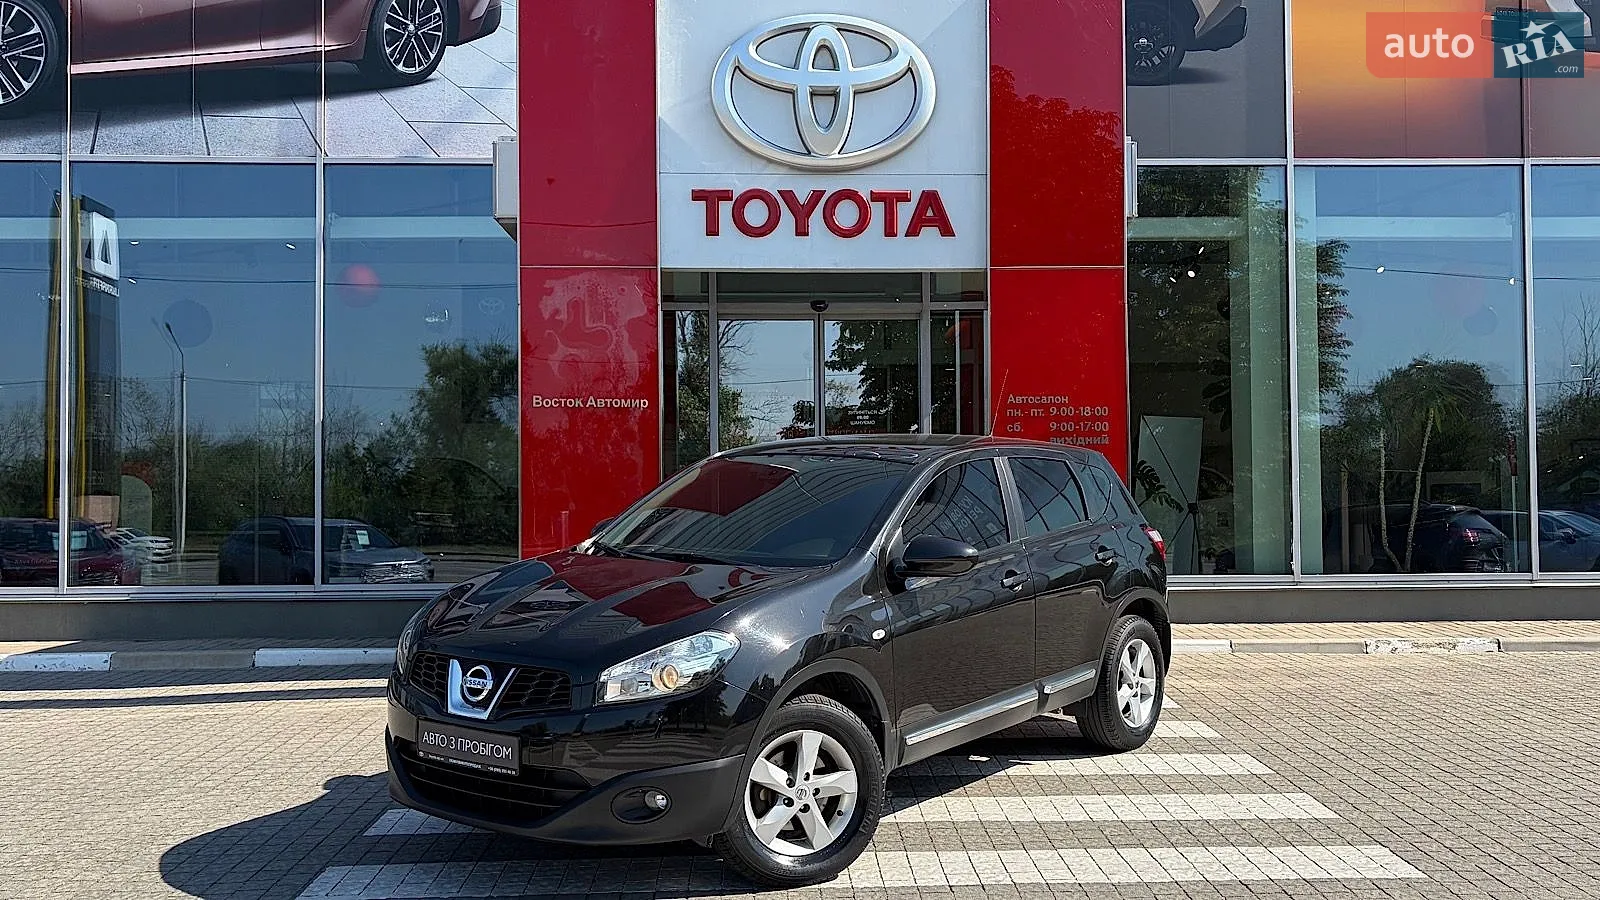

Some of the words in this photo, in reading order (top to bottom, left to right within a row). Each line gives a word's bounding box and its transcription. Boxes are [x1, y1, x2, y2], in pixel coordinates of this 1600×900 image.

[691, 188, 956, 238] TOYOTA
[532, 395, 584, 408] Восток
[586, 395, 649, 411] Автомир
[1007, 394, 1069, 404] Автосалон
[1006, 422, 1024, 432] сб.
[422, 731, 448, 747] АВТО
[457, 738, 512, 760] ПРОБІГОМ
